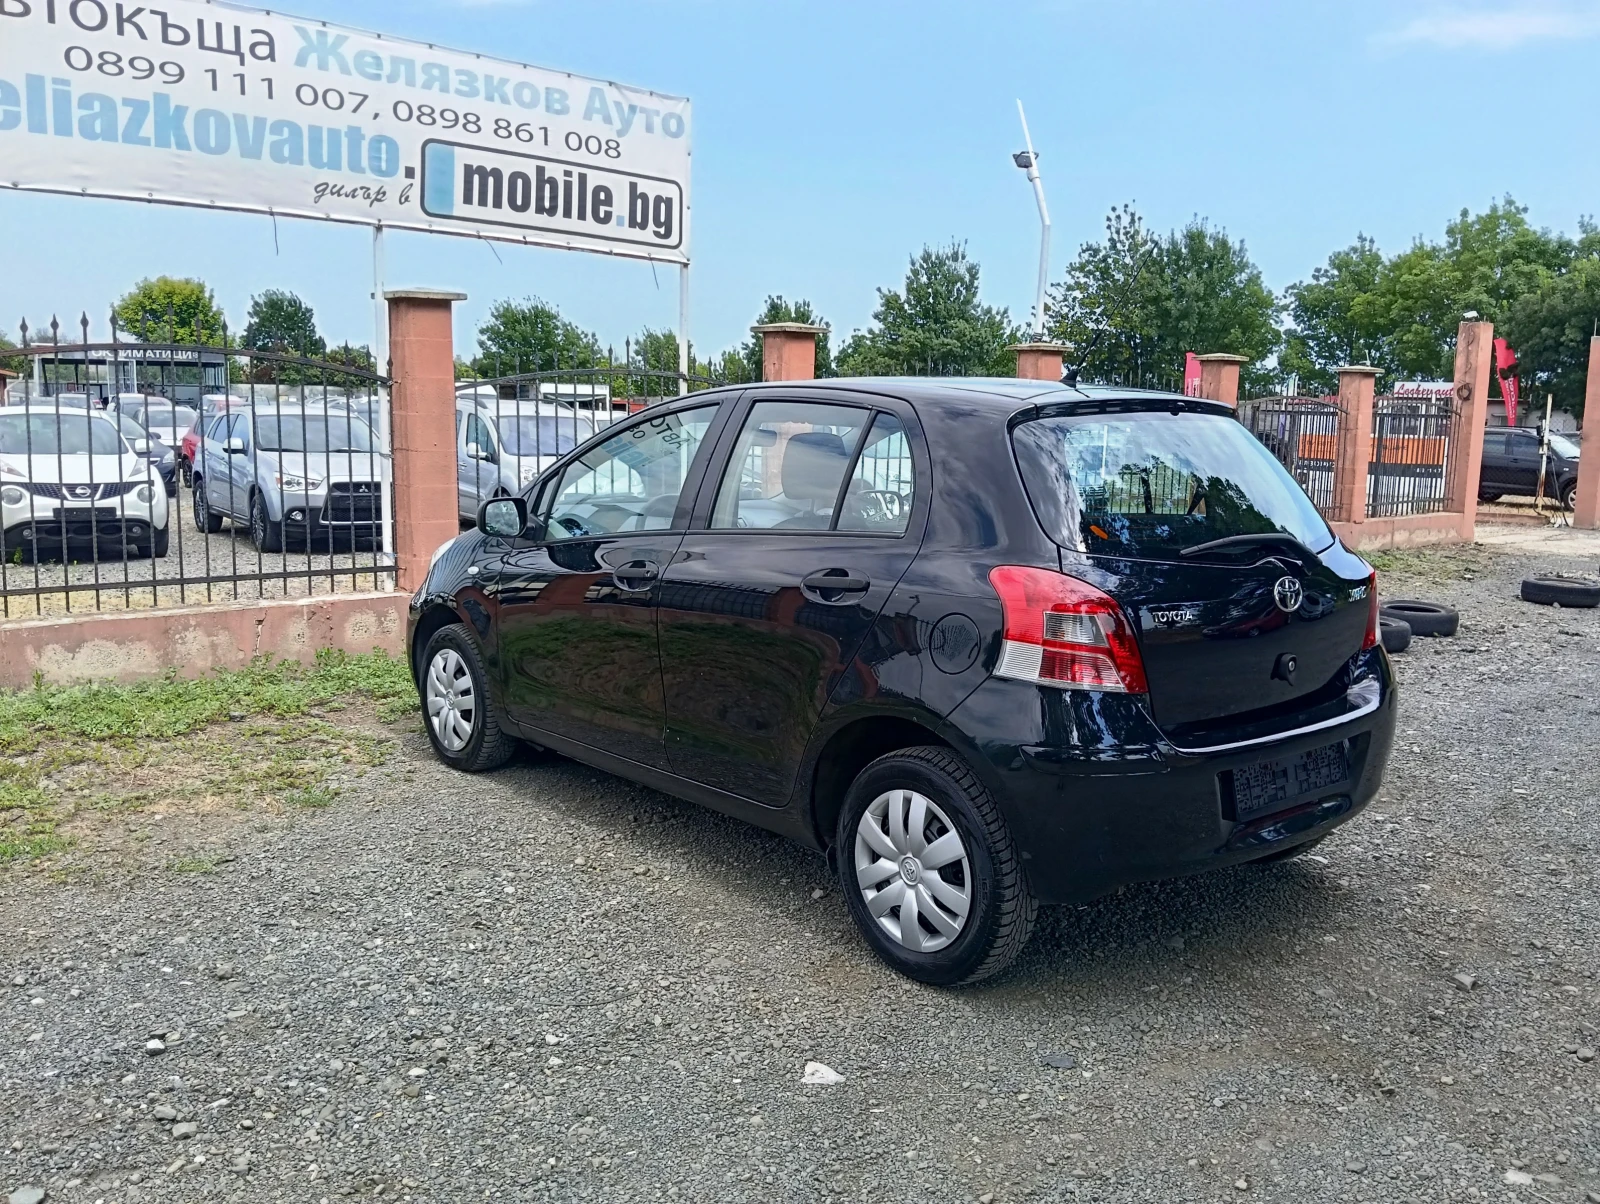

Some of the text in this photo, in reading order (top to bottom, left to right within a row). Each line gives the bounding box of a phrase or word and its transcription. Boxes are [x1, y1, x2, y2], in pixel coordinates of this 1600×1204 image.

[63, 45, 622, 158] 0899 111 007, 0898 861 008
[292, 25, 570, 116] Желязков
[582, 86, 685, 139] Ауто
[313, 181, 414, 208] дилър в
[462, 163, 673, 240] mobile.bg
[1152, 610, 1193, 623] TOYOTA
